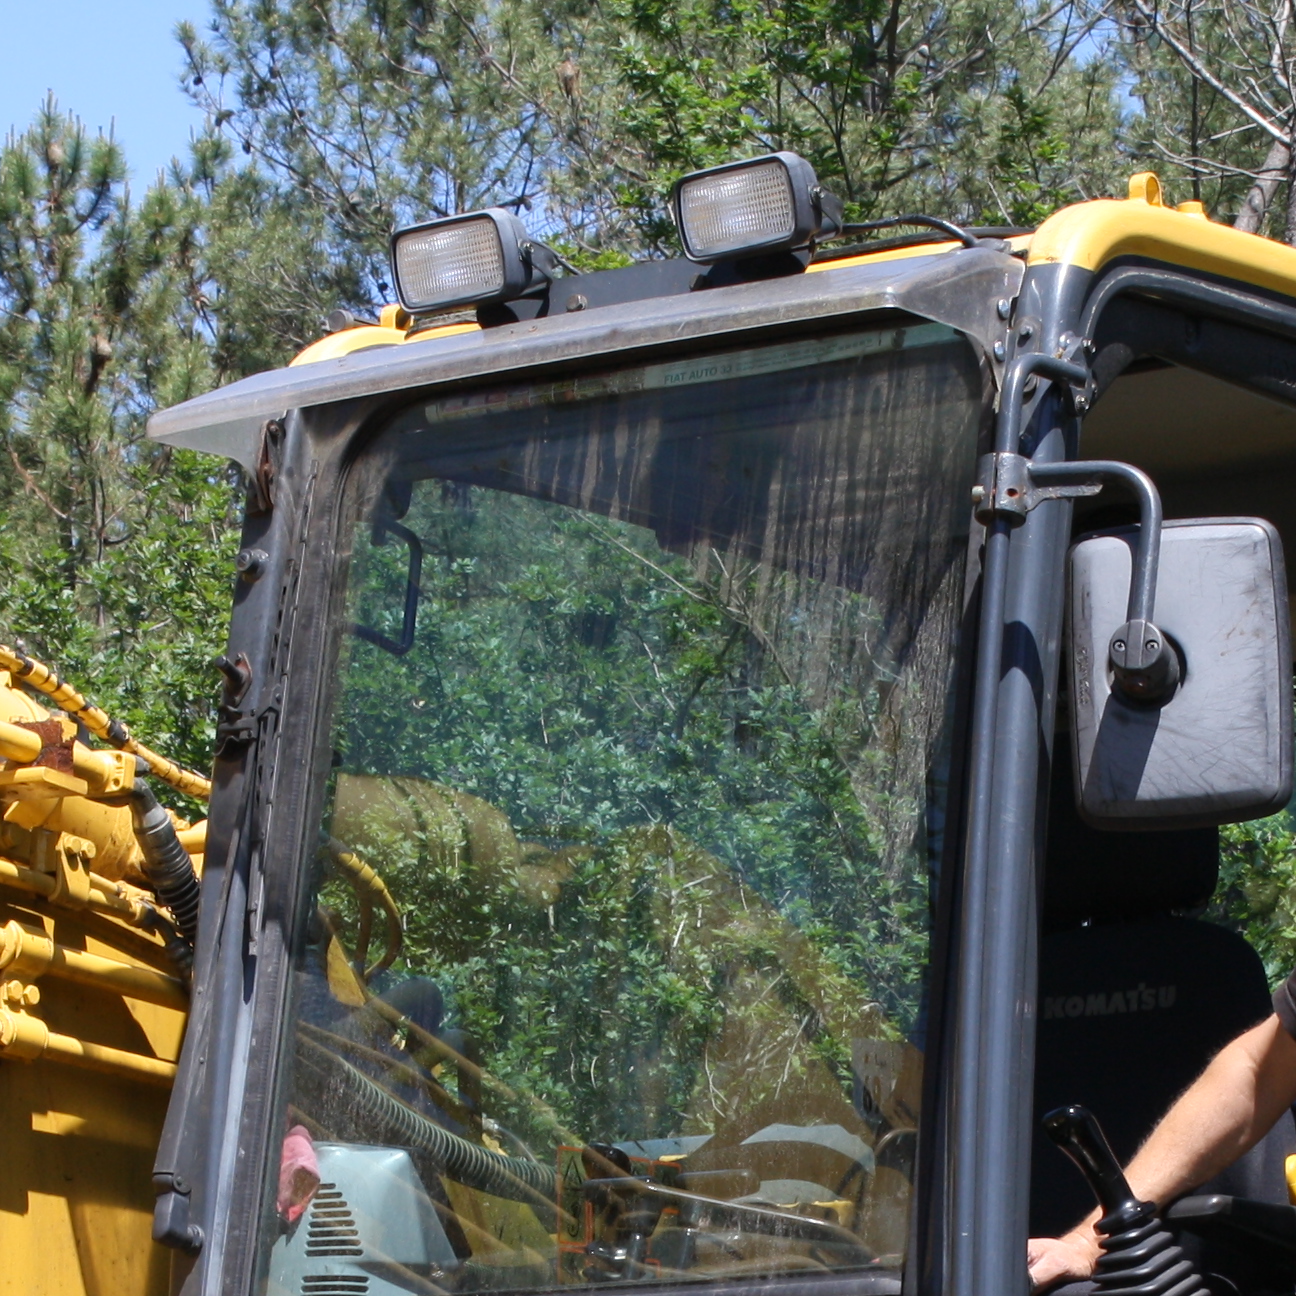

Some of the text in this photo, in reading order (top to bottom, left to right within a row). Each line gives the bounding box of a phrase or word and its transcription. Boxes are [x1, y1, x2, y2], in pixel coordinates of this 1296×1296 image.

[664, 372, 685, 385] FIAT
[689, 368, 718, 382] AUTO
[1043, 983, 1176, 1020] KOMATSU
